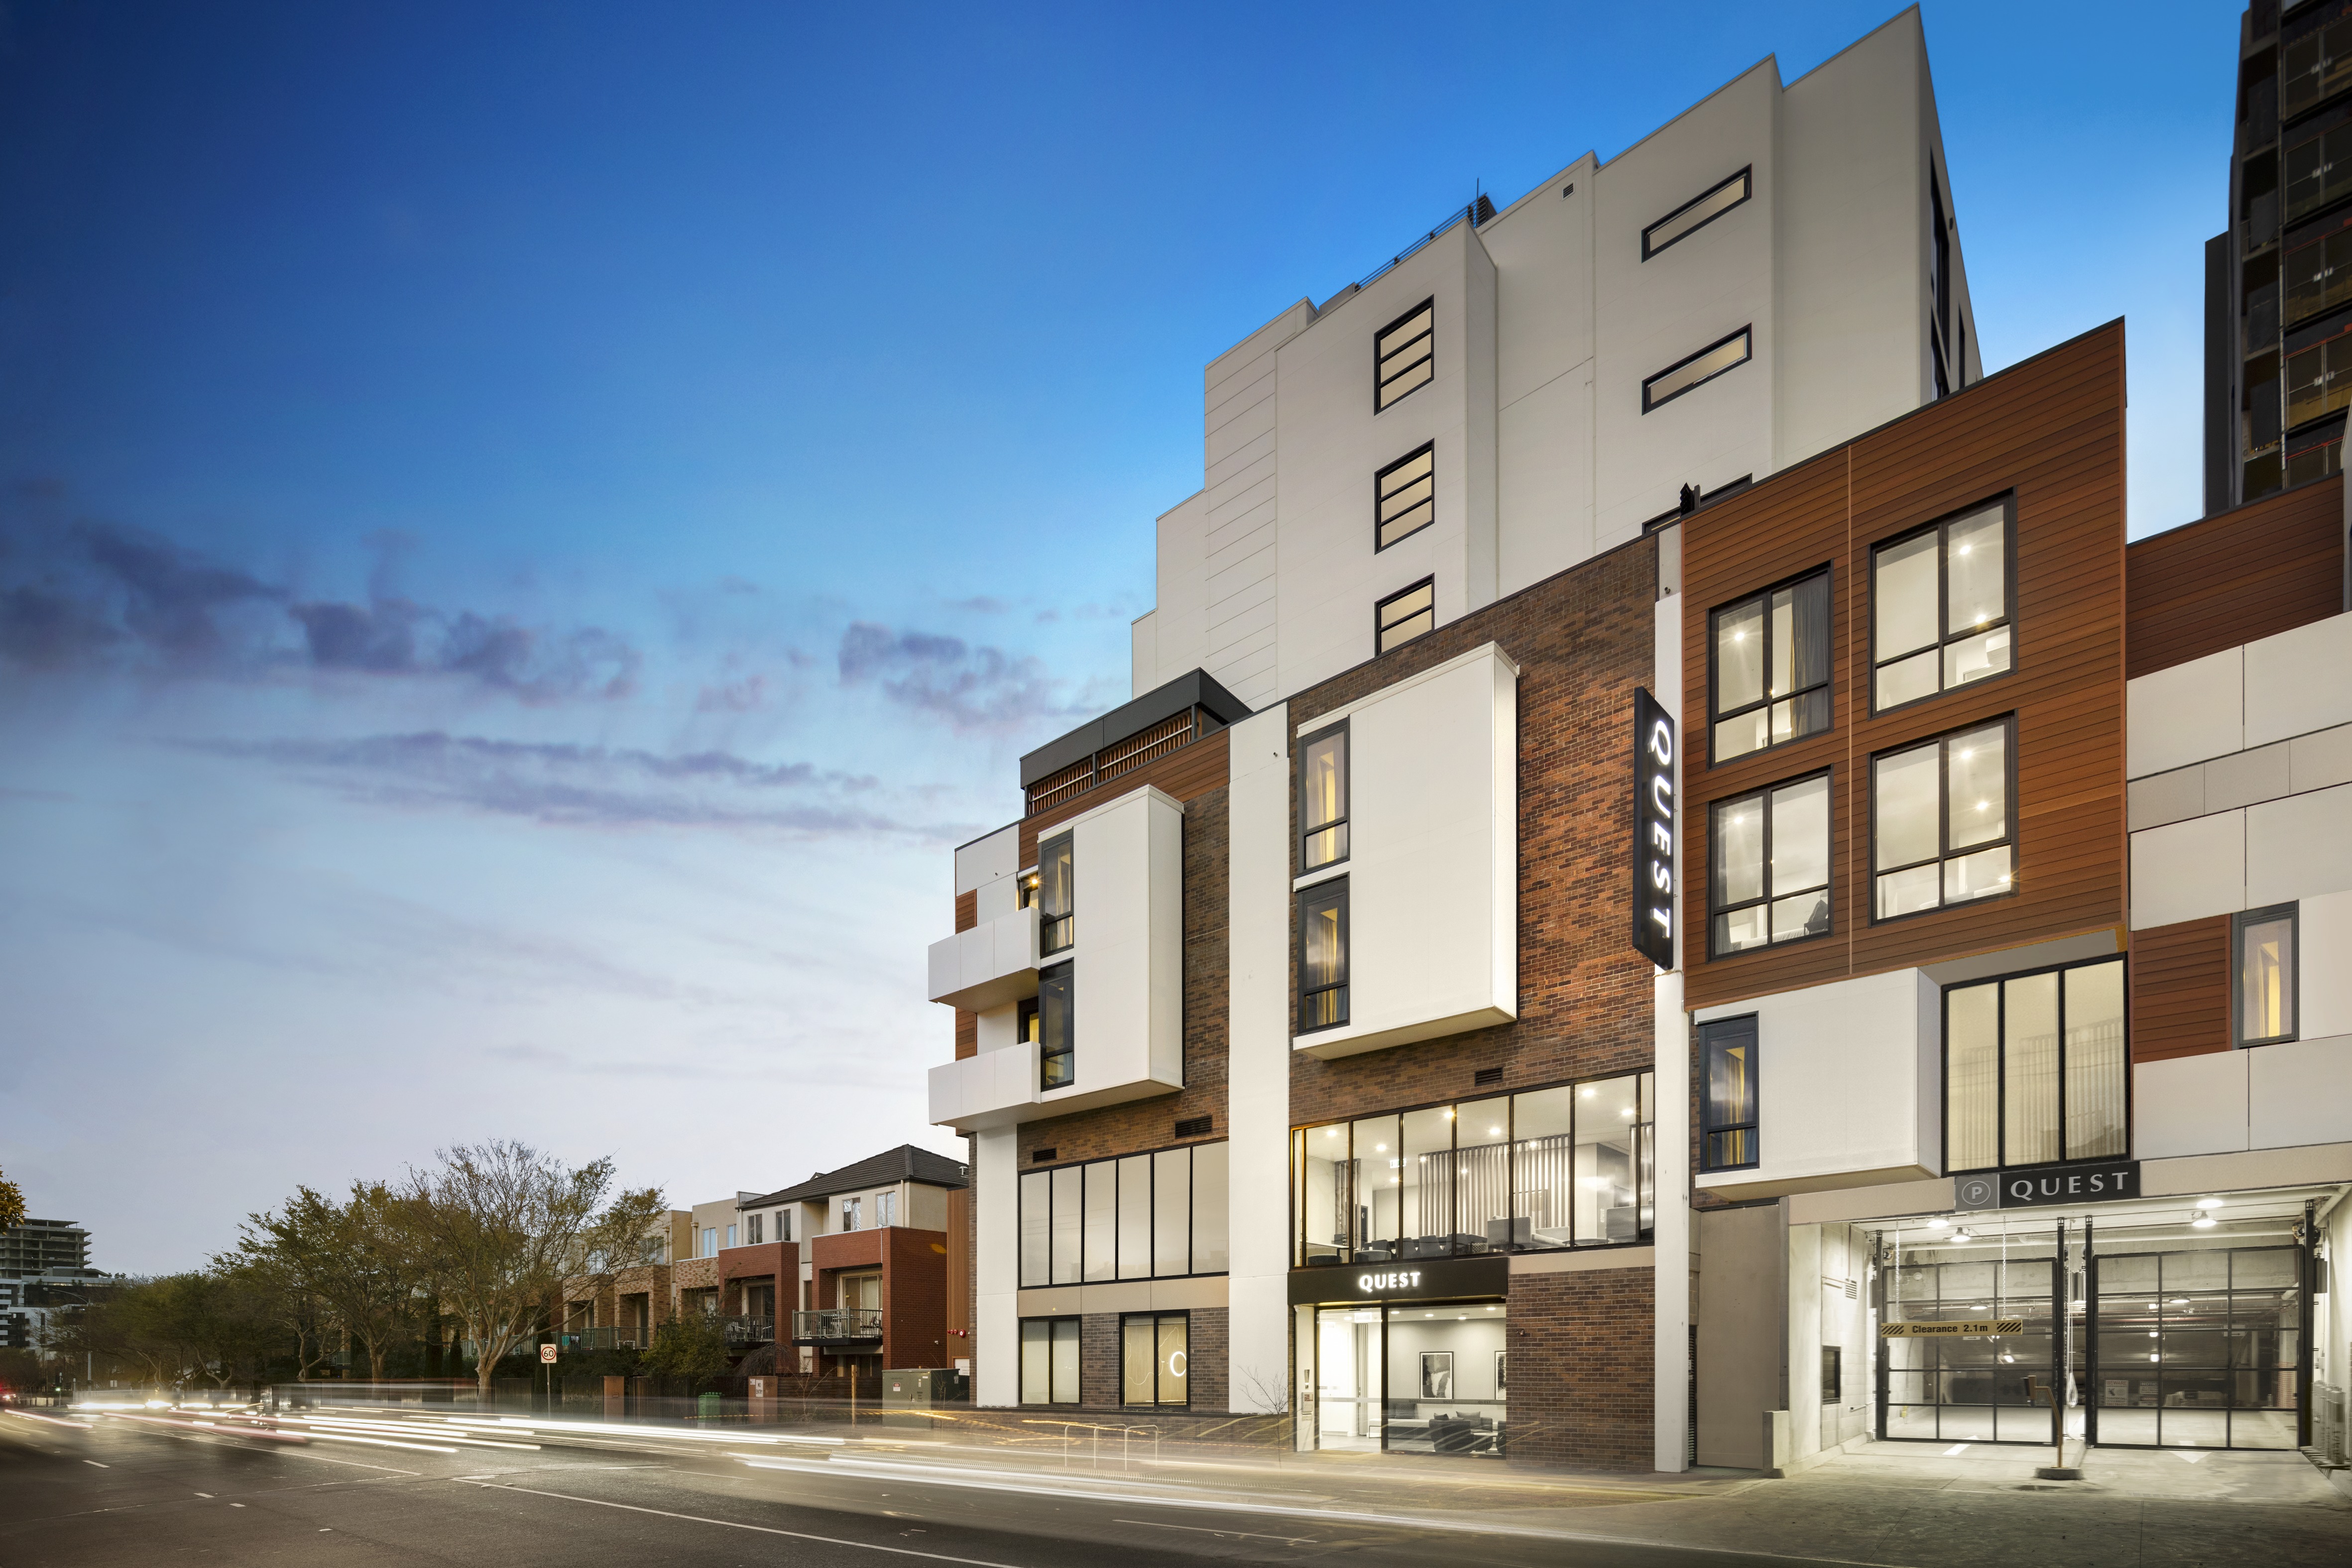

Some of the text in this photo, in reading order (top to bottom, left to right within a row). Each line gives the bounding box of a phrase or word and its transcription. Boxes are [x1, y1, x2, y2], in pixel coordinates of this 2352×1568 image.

[1648, 720, 1671, 939] QUEST
[1972, 1187, 1983, 1199] P
[2010, 1172, 2128, 1201] QUEST
[1359, 1271, 1421, 1293] QUEST
